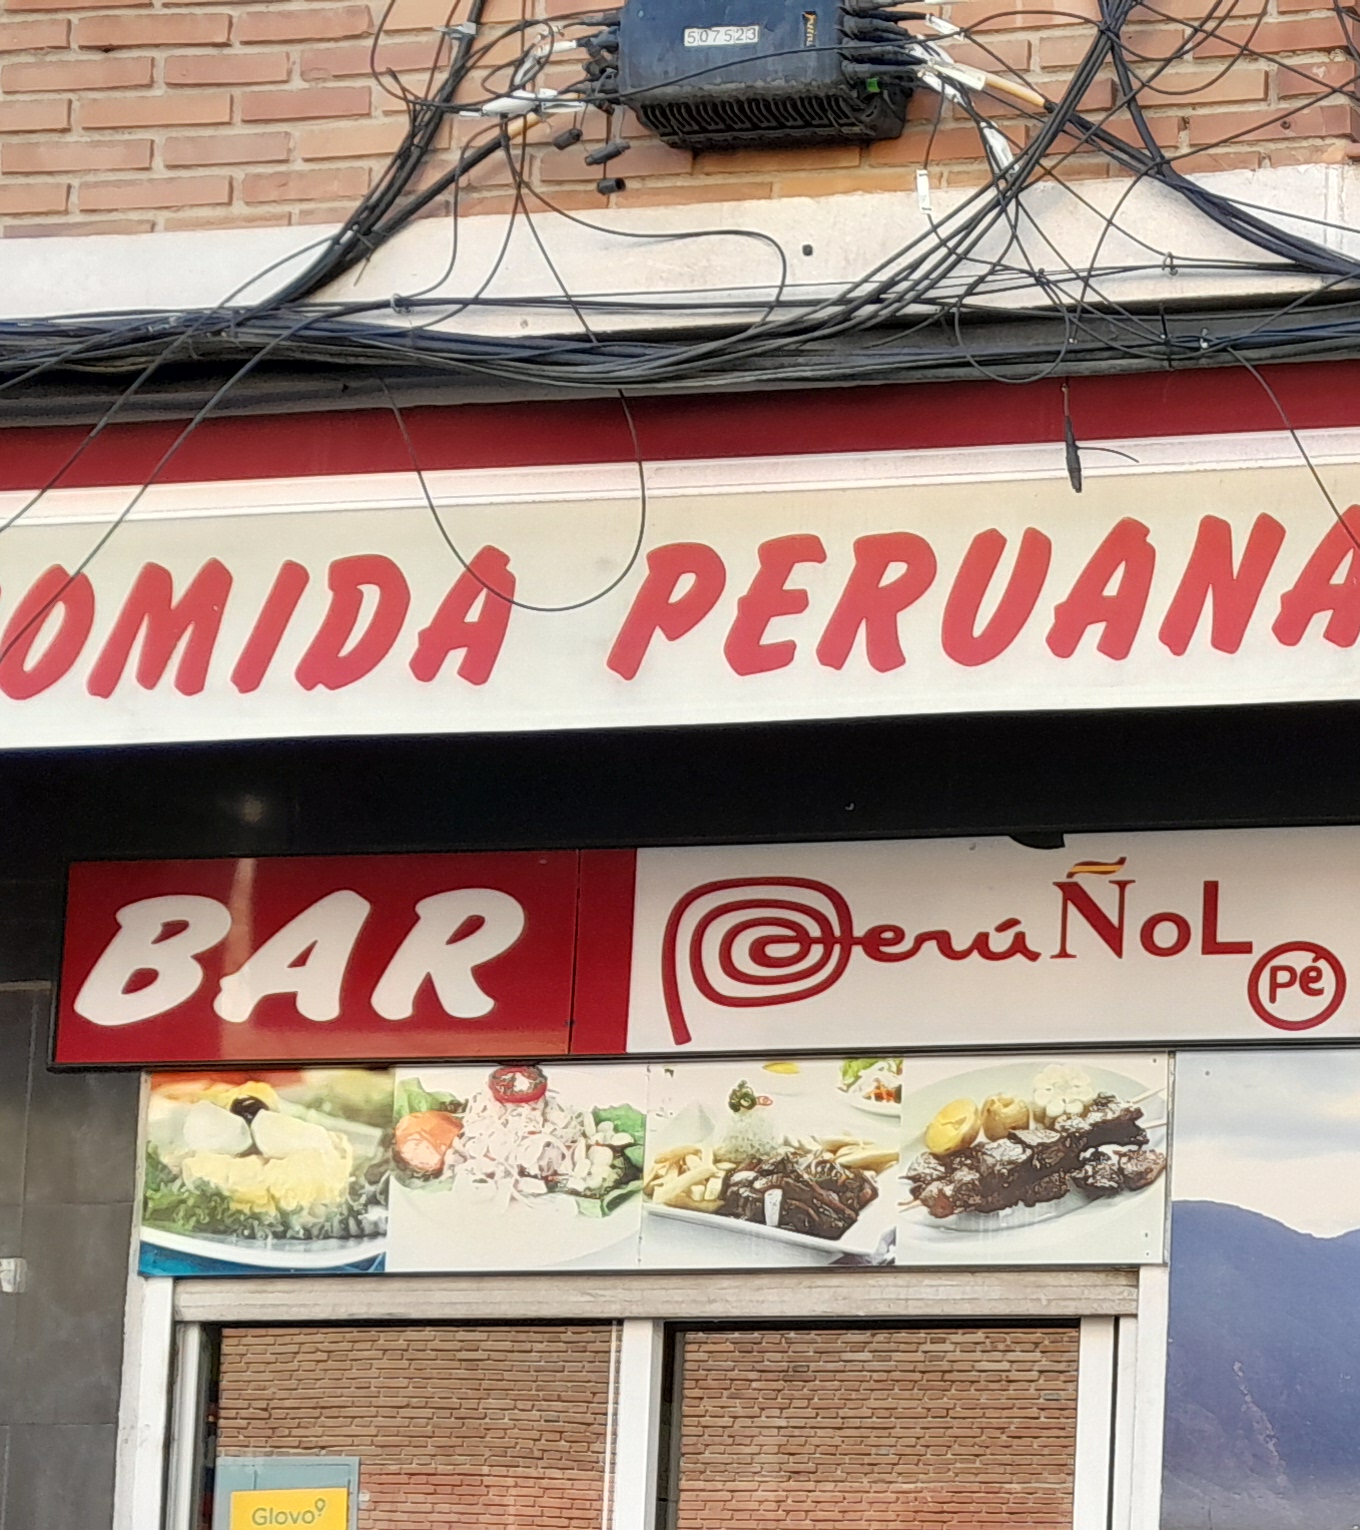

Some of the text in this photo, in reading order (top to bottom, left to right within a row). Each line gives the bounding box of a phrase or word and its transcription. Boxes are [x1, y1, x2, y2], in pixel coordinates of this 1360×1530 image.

[686, 27, 757, 45] 507523
[73, 887, 526, 1026] BAR
[252, 1507, 316, 1526] Glovo
